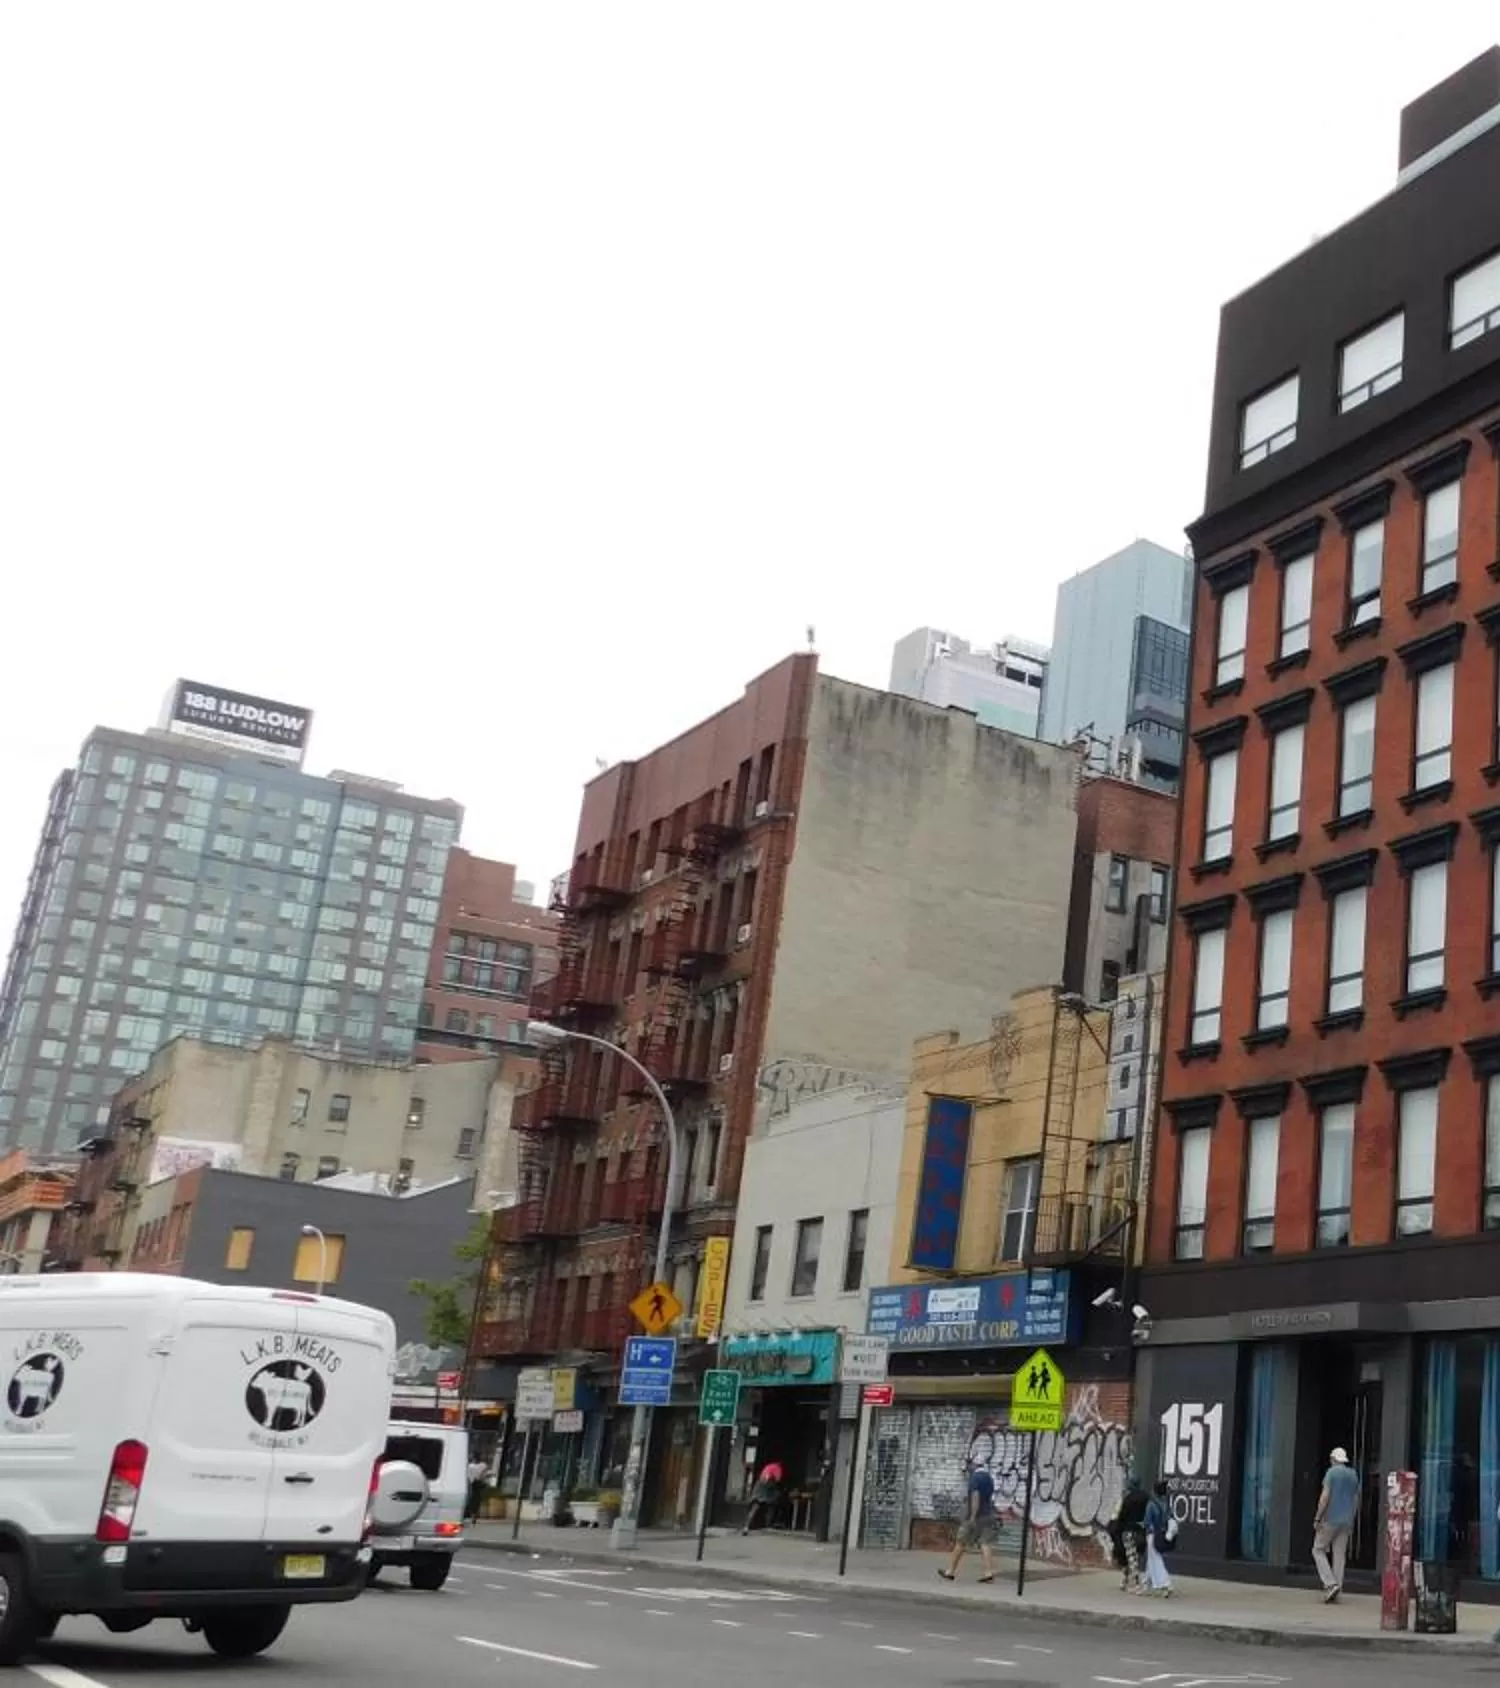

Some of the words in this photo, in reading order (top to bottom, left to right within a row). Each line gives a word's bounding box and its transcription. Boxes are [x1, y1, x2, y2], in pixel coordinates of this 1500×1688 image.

[183, 708, 234, 726] LUXURY
[241, 721, 298, 741] RENTALS
[184, 691, 217, 711] 188
[220, 699, 305, 731] LUDLOW
[900, 1325, 936, 1344] GOOD
[938, 1322, 976, 1342] TASTE
[979, 1320, 1019, 1342] CORP.
[294, 1336, 342, 1373] MEATS
[1017, 1411, 1056, 1425] AHEAD
[1161, 1403, 1223, 1476] 151
